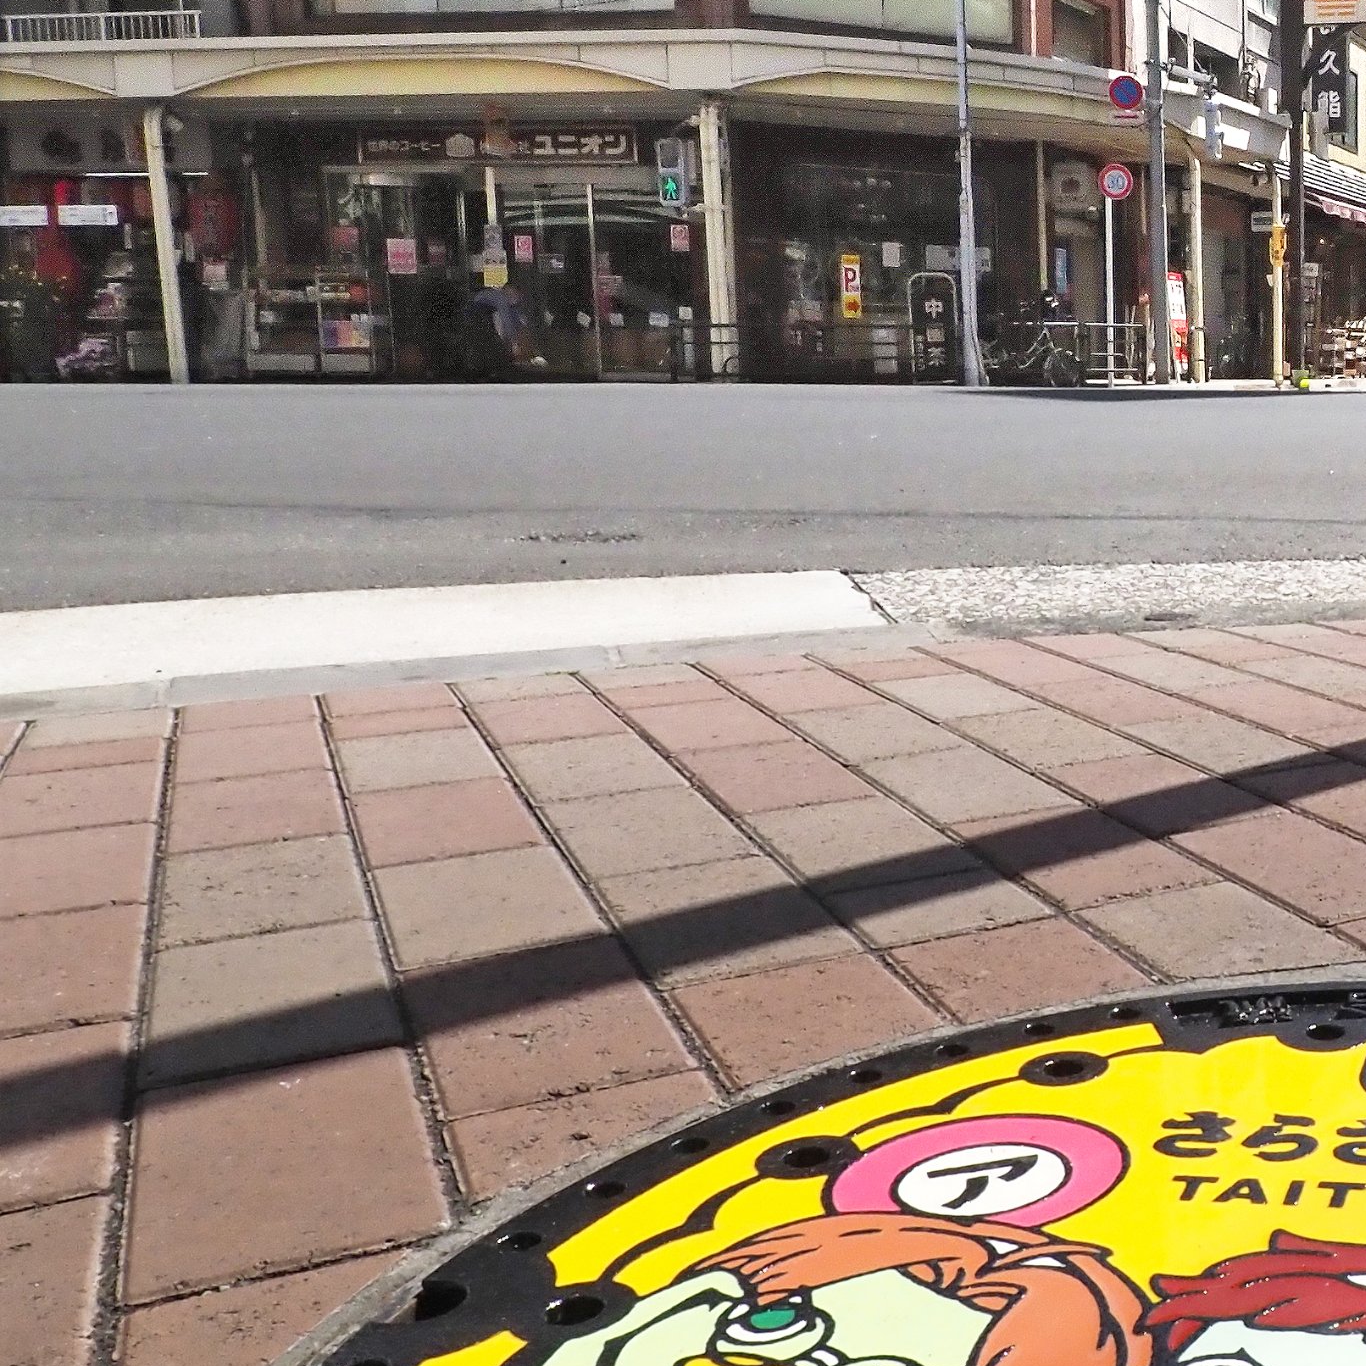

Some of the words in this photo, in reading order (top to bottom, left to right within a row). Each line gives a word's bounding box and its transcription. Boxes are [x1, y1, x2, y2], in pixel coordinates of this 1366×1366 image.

[533, 133, 628, 156] ユニオン
[926, 1153, 1039, 1211] ア
